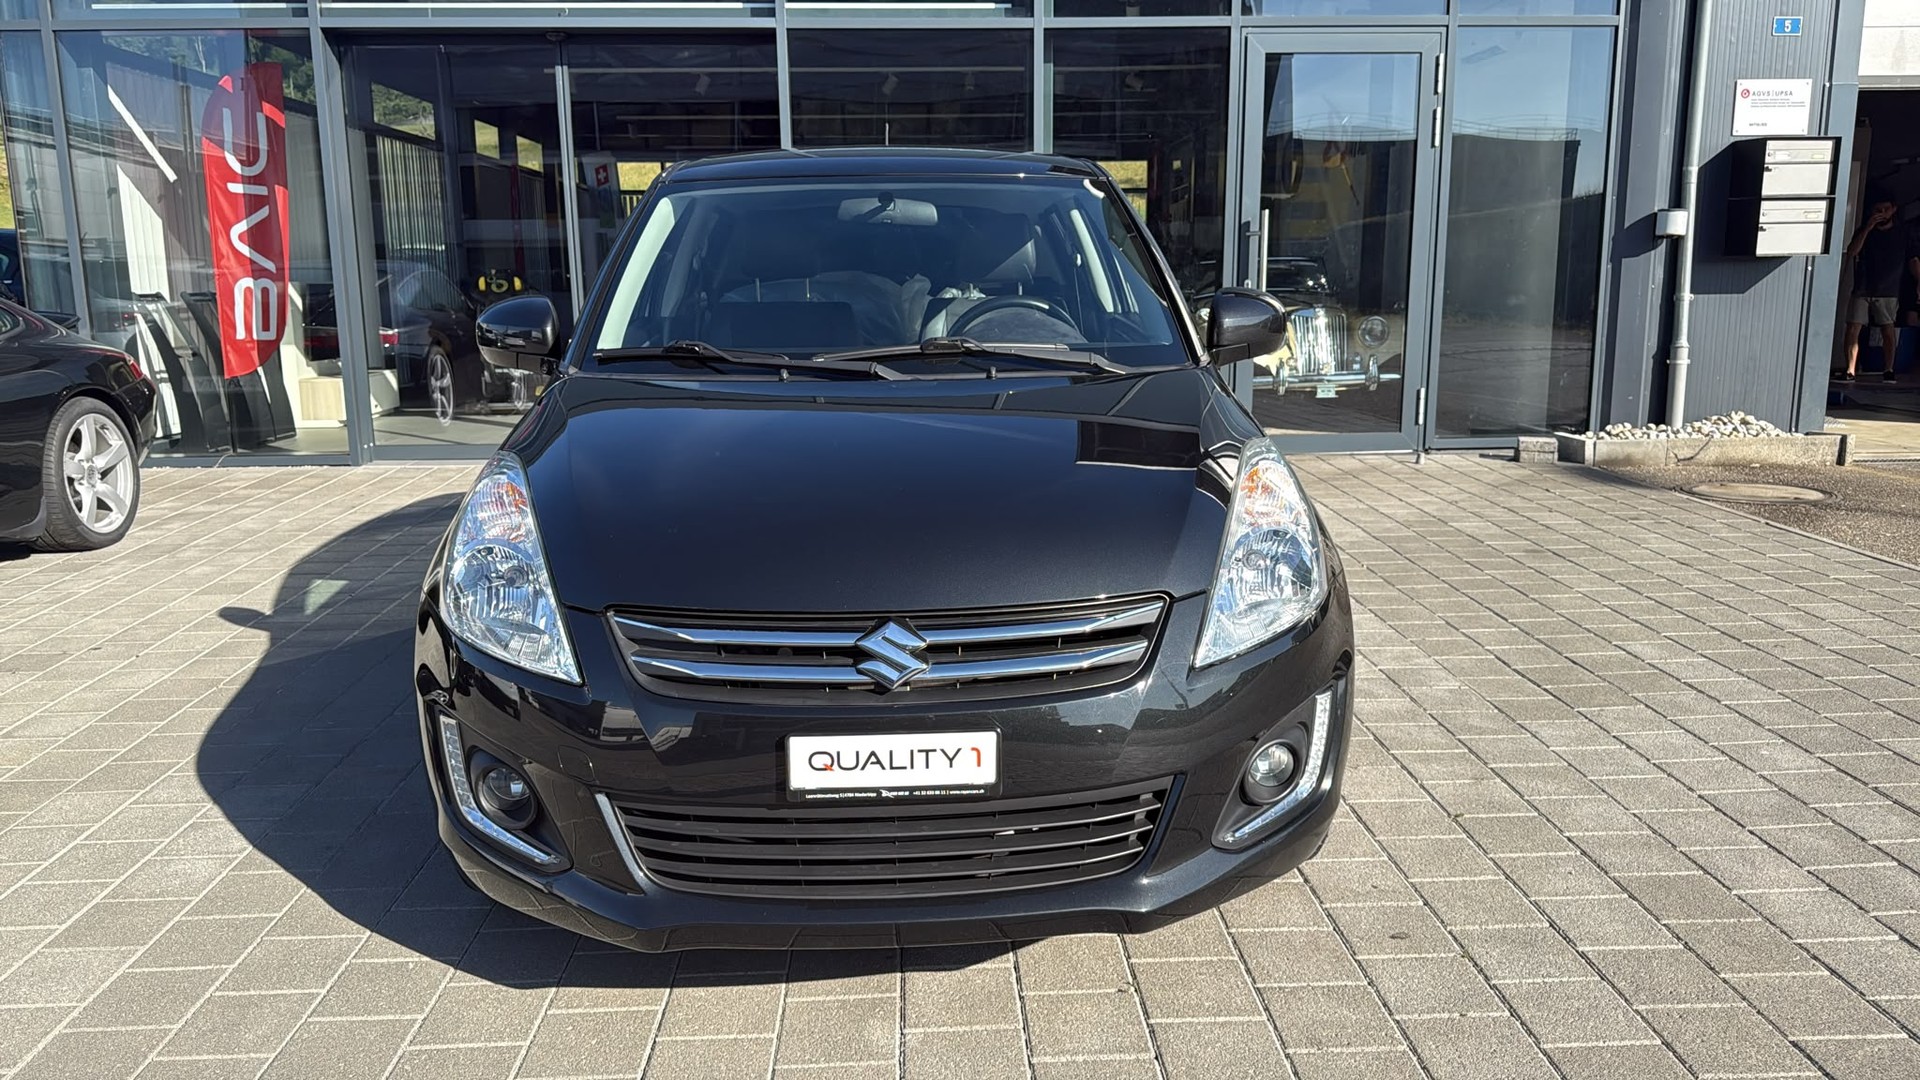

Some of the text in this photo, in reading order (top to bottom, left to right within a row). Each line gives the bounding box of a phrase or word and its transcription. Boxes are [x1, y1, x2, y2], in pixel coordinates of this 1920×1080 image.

[1784, 20, 1792, 32] 5
[222, 107, 278, 341] BAIC
[808, 747, 982, 772] QUALITY 1
